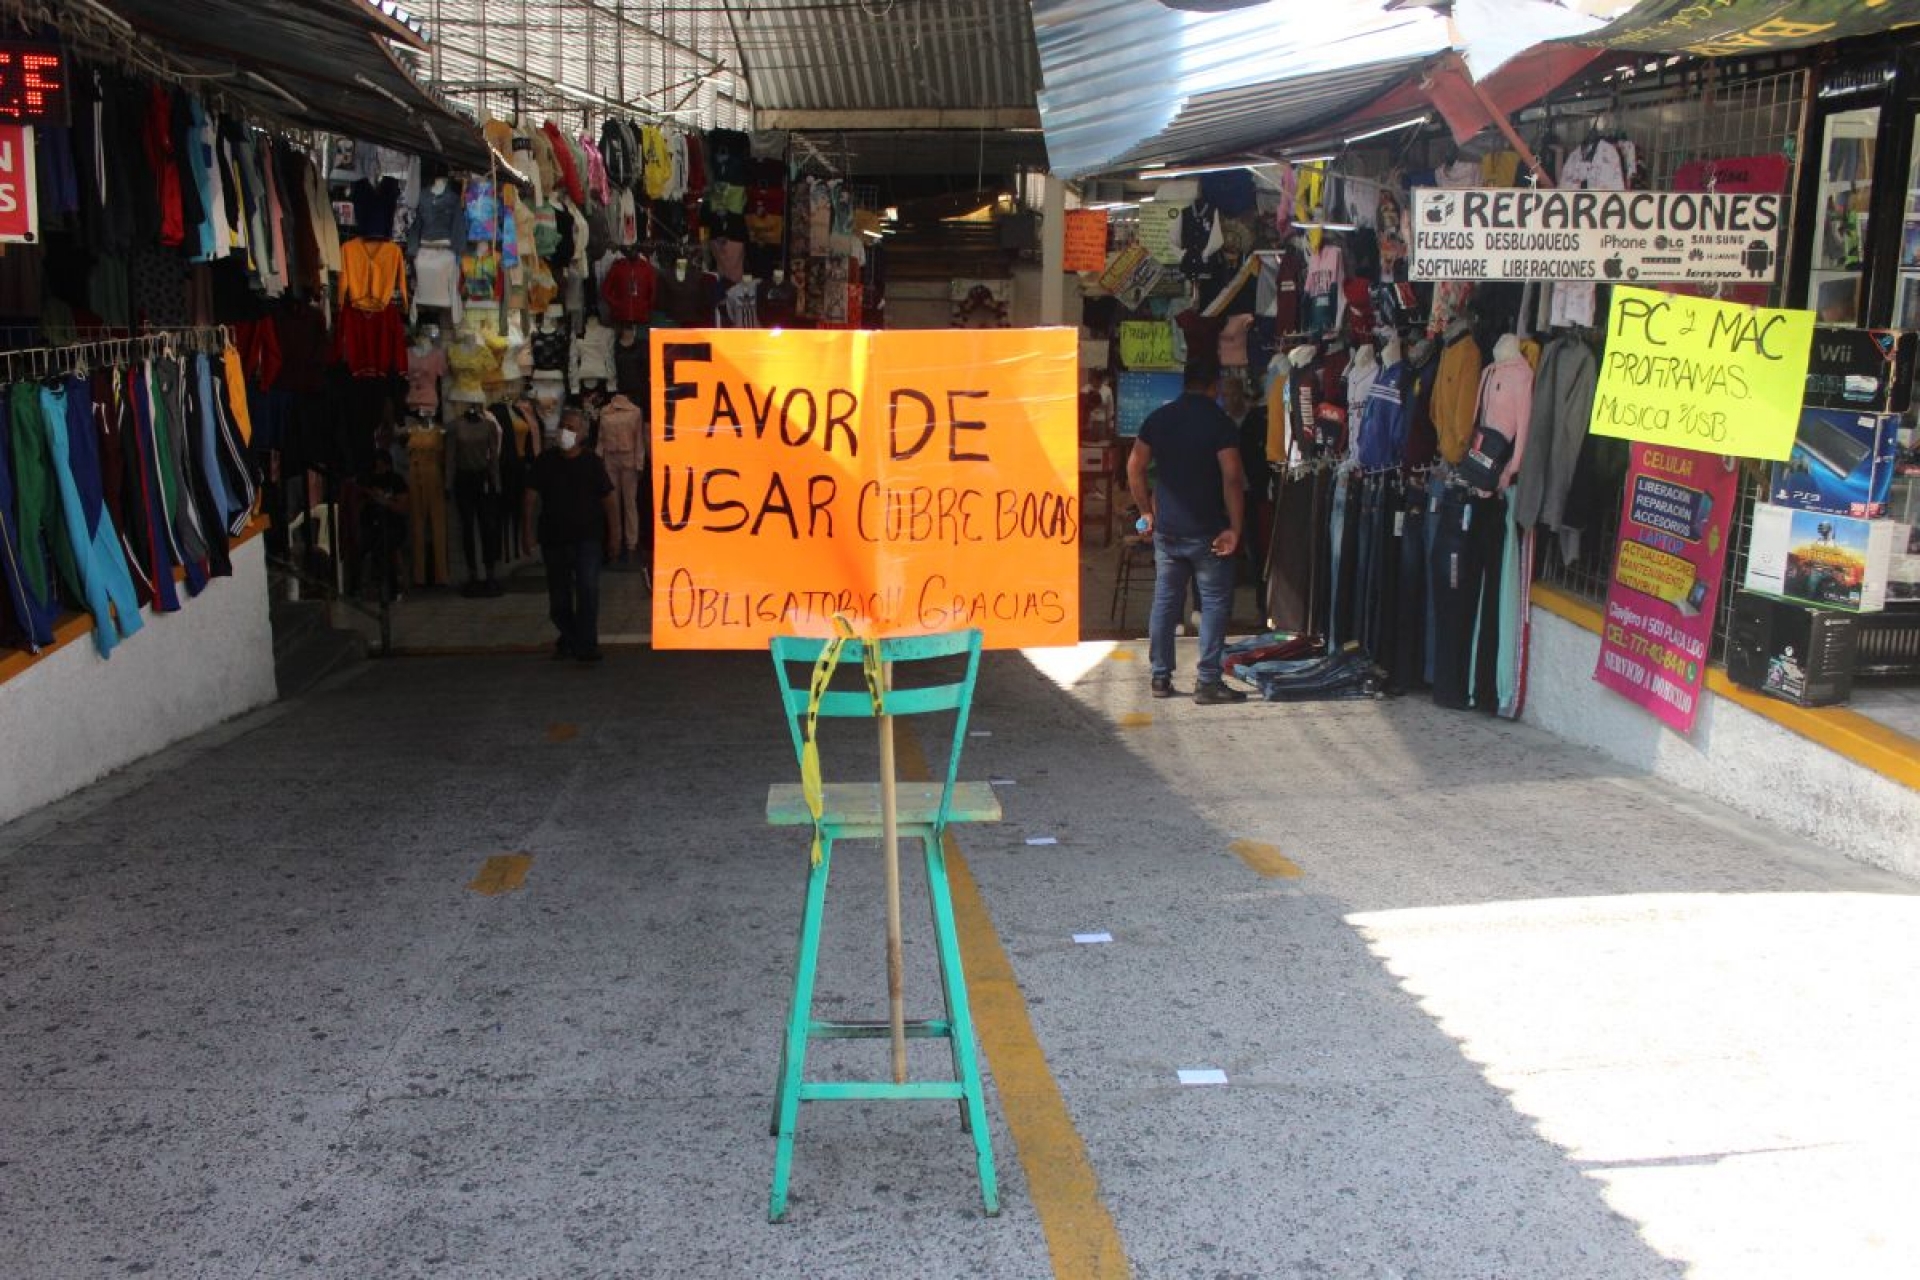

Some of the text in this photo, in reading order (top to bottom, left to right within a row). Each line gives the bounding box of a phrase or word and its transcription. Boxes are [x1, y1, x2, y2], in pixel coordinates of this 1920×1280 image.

[1463, 191, 1778, 232] REPARACIONES
[1417, 232, 1580, 251] FLEXEOS DESBLOQUEOS
[1600, 235, 1647, 249] iPhone
[1417, 258, 1596, 278] SOFTWARE LIBERACIONES
[1618, 298, 1670, 346] PC
[1708, 310, 1787, 361] MAC
[1820, 344, 1852, 362] Wii
[662, 342, 989, 461] FAVOR DE
[1642, 450, 1694, 475] CELULAR
[661, 465, 1077, 545] USAR CUBRE BOCAS
[919, 575, 1065, 631] GRACIAS
